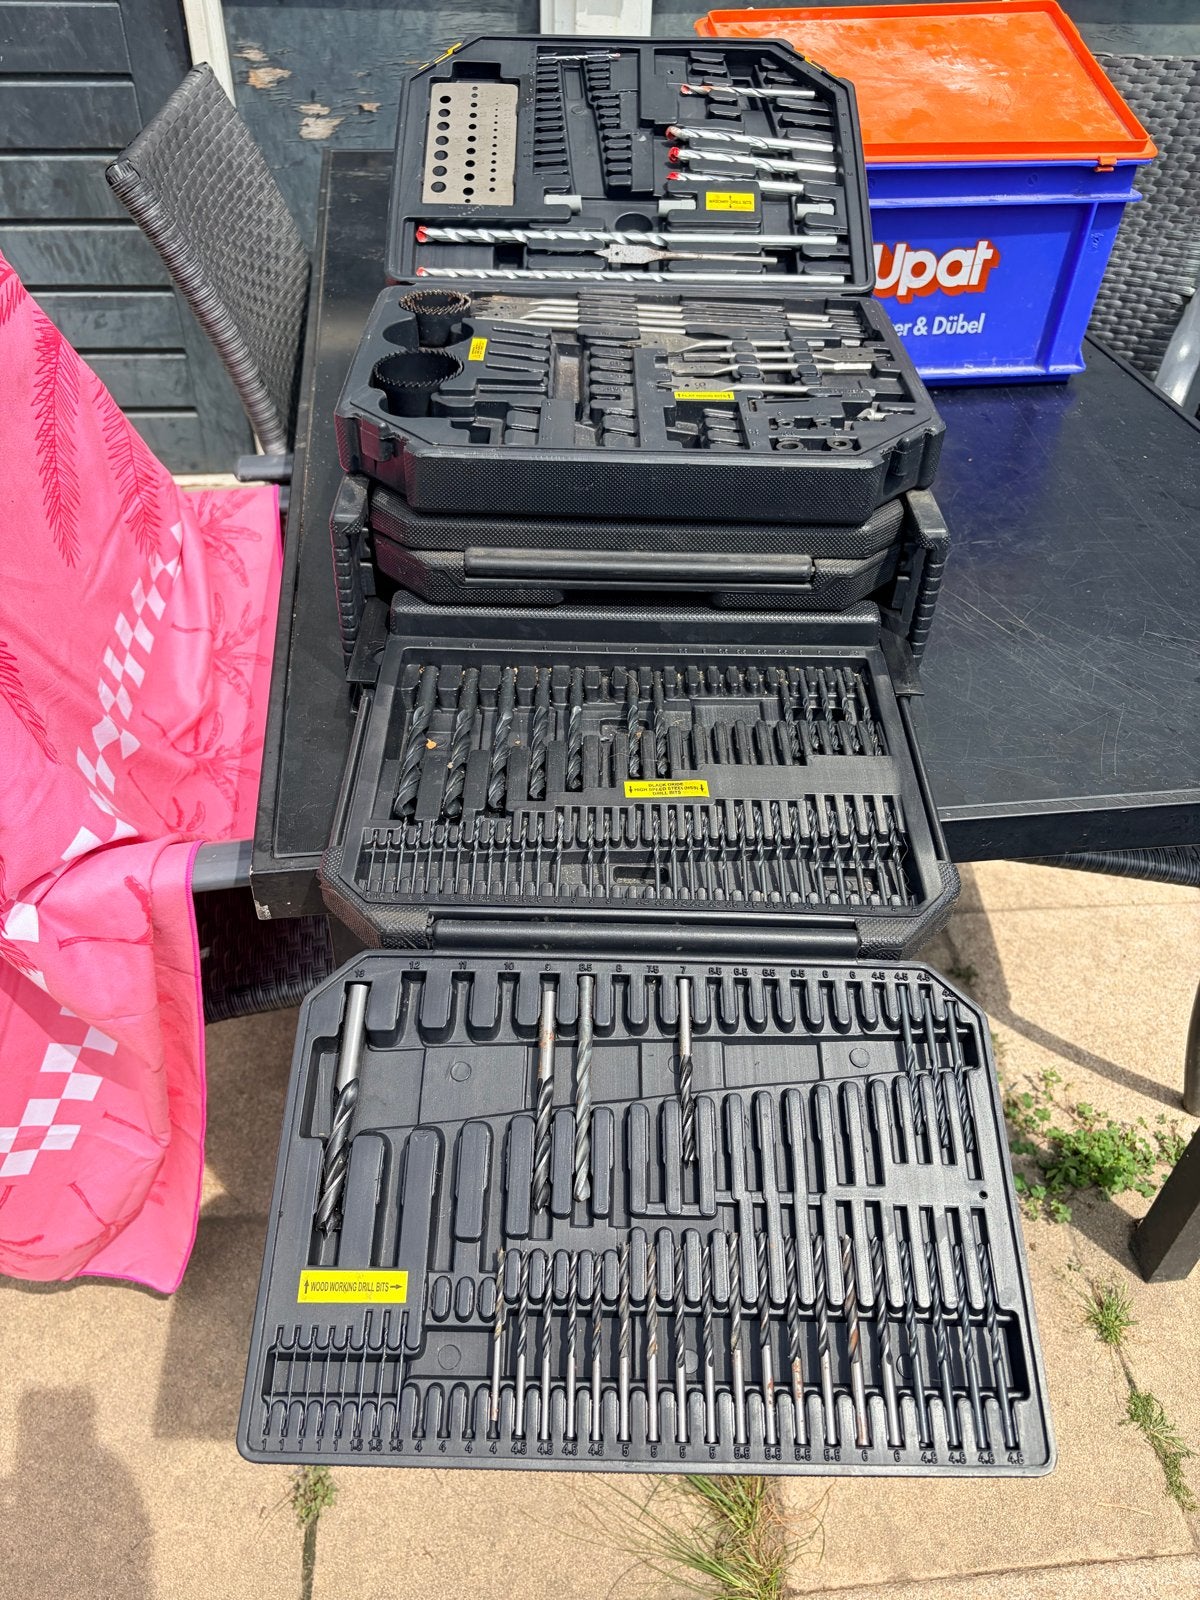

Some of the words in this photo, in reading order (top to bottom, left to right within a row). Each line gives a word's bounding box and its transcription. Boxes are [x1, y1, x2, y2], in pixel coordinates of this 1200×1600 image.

[873, 240, 995, 297] Upat
[913, 316, 928, 336] &
[932, 312, 986, 335] Dübel
[409, 961, 420, 970] 12
[458, 961, 467, 970] 11
[504, 962, 514, 970] 10
[680, 965, 687, 974] 7
[822, 970, 829, 978] 6
[849, 970, 856, 979] 6
[358, 1282, 375, 1292] DRILL
[375, 1282, 389, 1292] BITS
[261, 1438, 267, 1451] 1
[279, 1438, 285, 1451] 1
[298, 1439, 304, 1451] 1
[316, 1439, 322, 1451] 1
[333, 1439, 339, 1451] 1
[349, 1439, 364, 1452] 1.5
[368, 1439, 383, 1452] 1.5
[389, 1439, 403, 1452] 1.5
[415, 1440, 423, 1452] 4
[439, 1440, 446, 1452] 4
[465, 1440, 473, 1453] 4
[489, 1441, 497, 1454] 4
[511, 1441, 527, 1455] 4.5
[537, 1442, 553, 1456] 4.5
[562, 1442, 578, 1456] 4.5
[588, 1443, 604, 1456] 4.5
[622, 1444, 629, 1457] 5
[650, 1445, 658, 1458] 5
[679, 1445, 686, 1458] 5
[709, 1446, 716, 1459] 5
[734, 1446, 750, 1460] 5.5
[764, 1447, 782, 1460] 5.5
[794, 1447, 812, 1461] 5.5
[824, 1448, 841, 1462] 5.5
[861, 1449, 868, 1462] 6
[893, 1449, 900, 1462] 6
